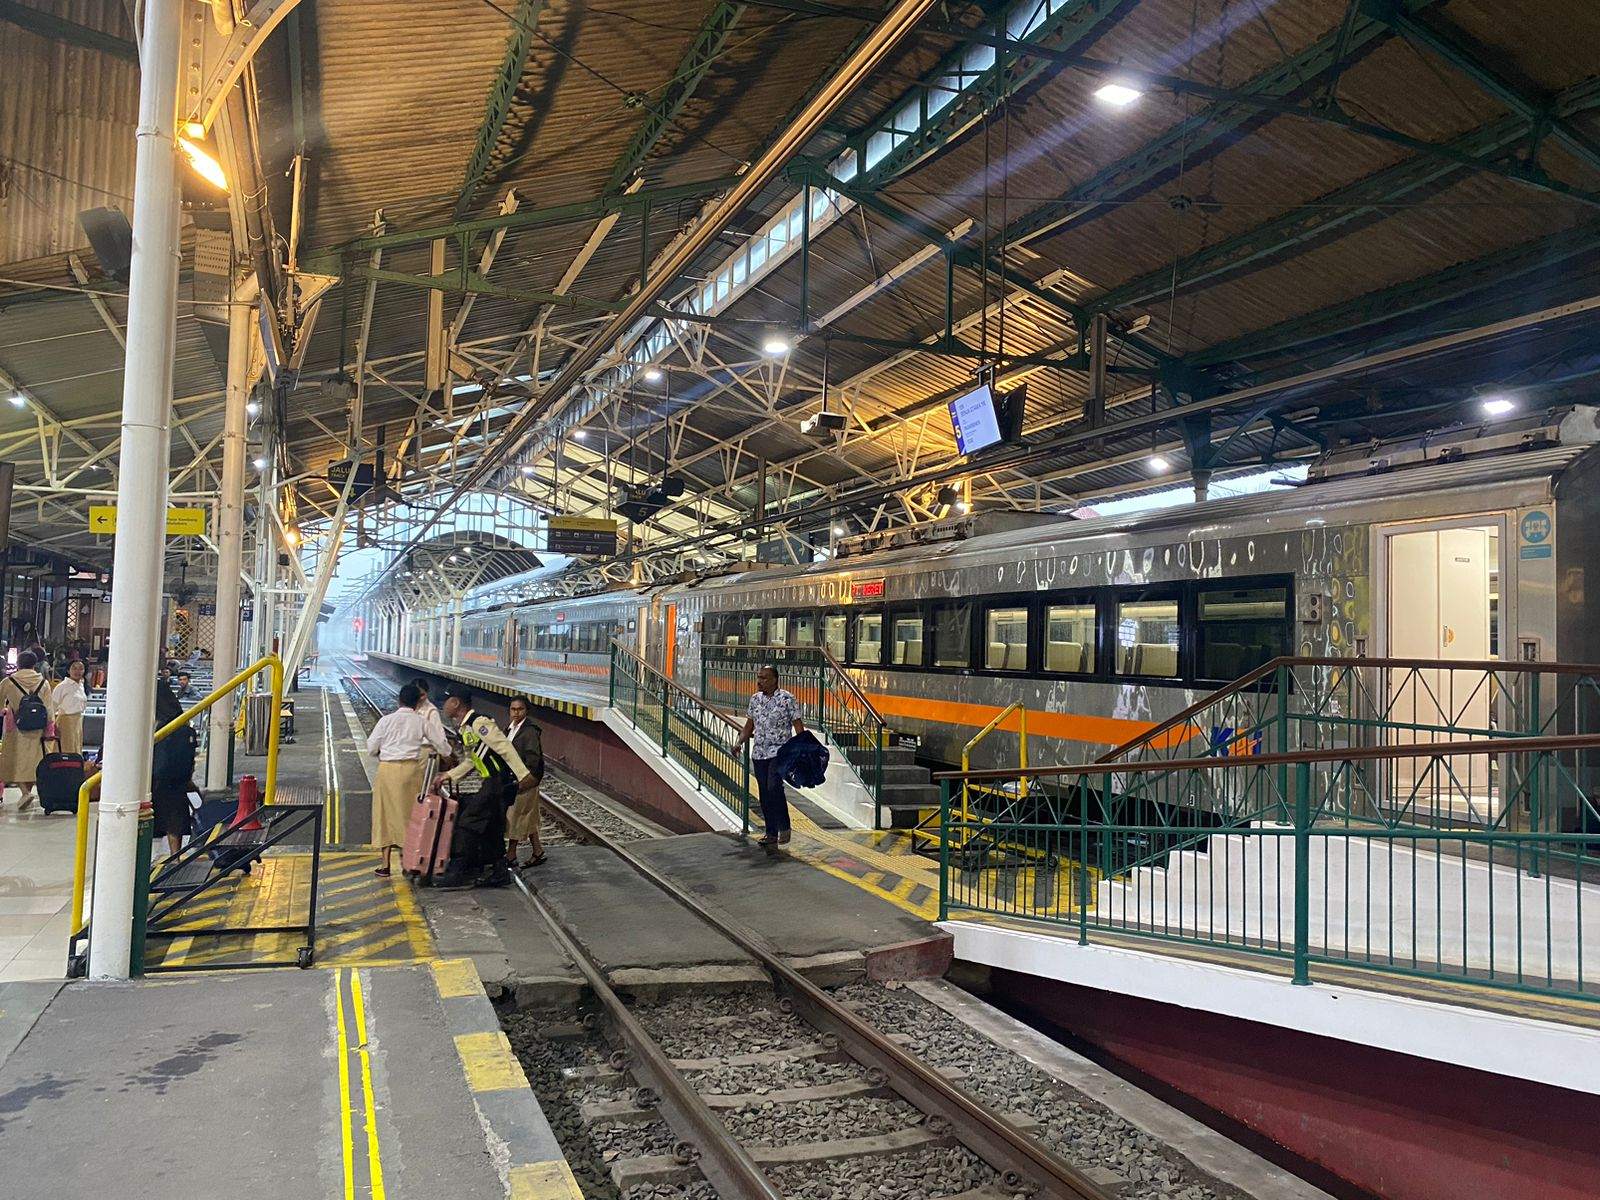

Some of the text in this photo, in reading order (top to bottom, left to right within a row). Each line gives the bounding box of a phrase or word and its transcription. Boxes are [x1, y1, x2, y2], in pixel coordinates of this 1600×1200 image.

[955, 426, 962, 439] 5
[331, 466, 352, 474] JALU
[638, 507, 648, 517] 5
